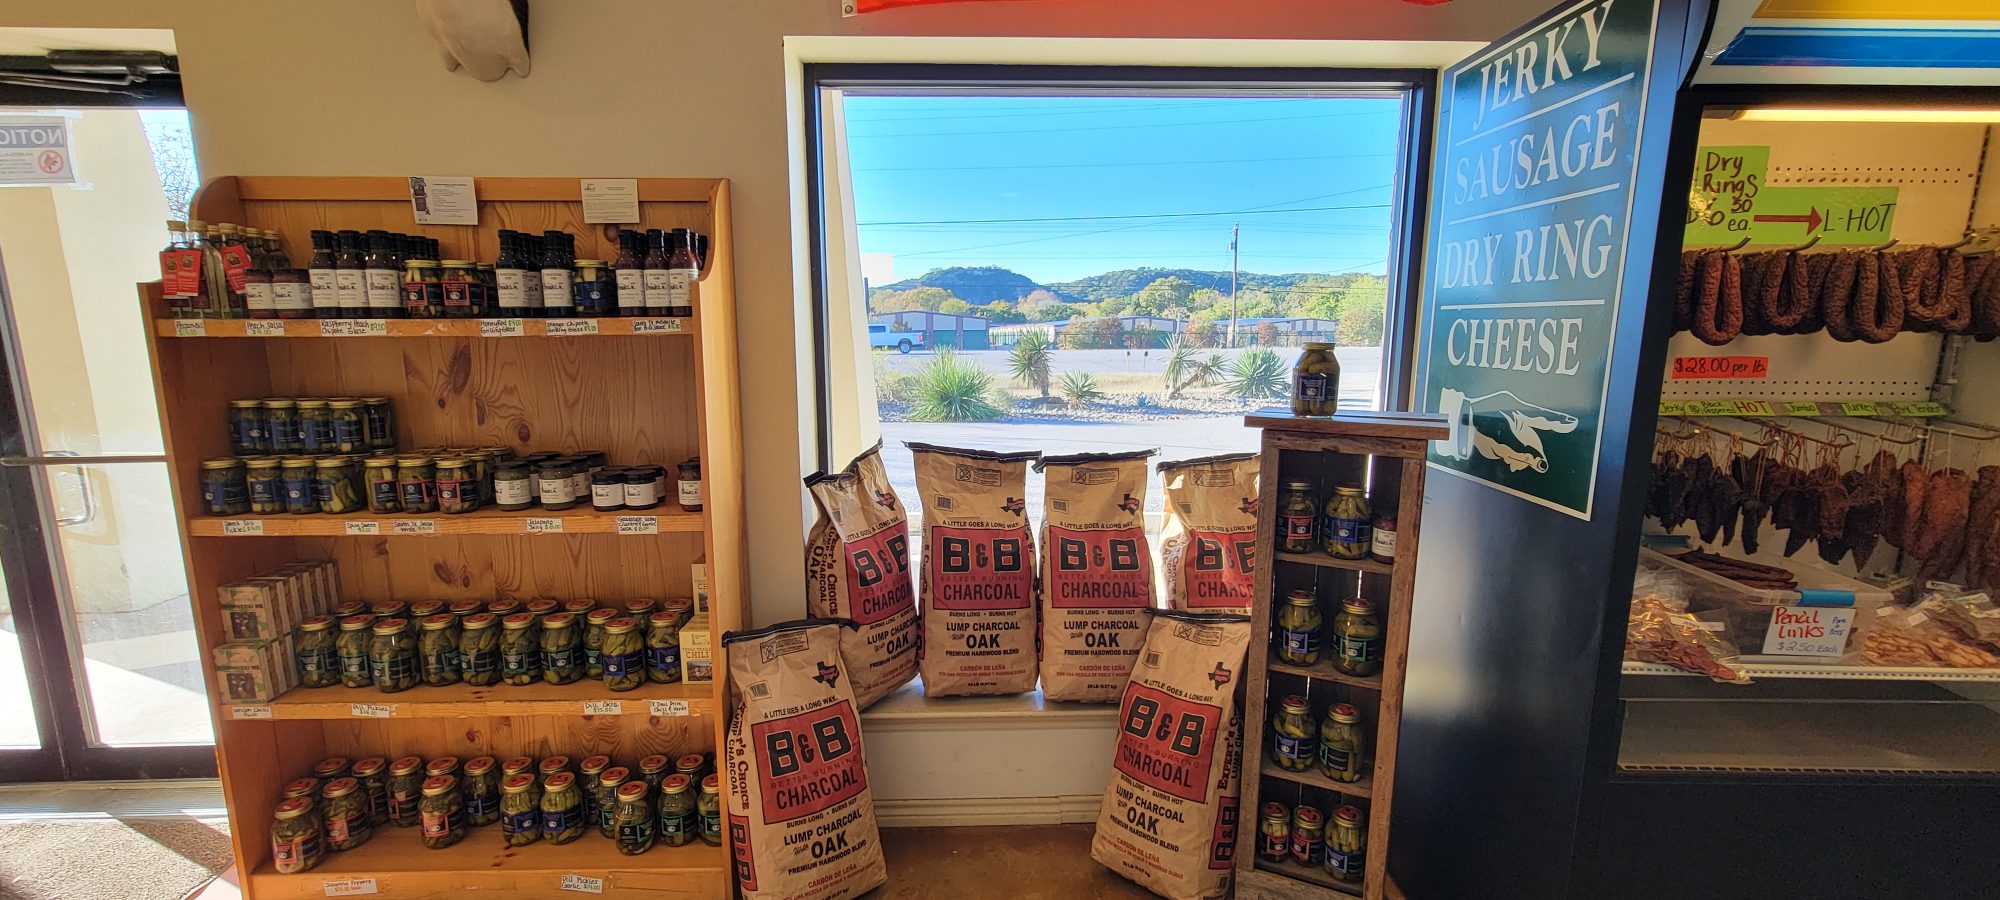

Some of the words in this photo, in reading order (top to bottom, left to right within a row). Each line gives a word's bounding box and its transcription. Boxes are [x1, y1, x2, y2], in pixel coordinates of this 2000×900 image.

[1473, 4, 1611, 130] JERKY
[1454, 101, 1621, 207] SAUSAGE
[1705, 151, 1743, 178] Dry
[1823, 203, 1897, 232] L-HOT
[1443, 233, 1503, 290] DRY
[1511, 213, 1612, 284] RING
[247, 321, 265, 330] Peach
[1447, 317, 1583, 376] CHEESE
[1674, 357, 1730, 374] $28.00
[1731, 363, 1749, 377] per
[1733, 400, 1768, 413] HOT
[876, 520, 891, 530] LONG
[1064, 521, 1083, 529] LITTLE
[810, 546, 824, 581] OAK
[942, 536, 1022, 574] B&B
[1059, 535, 1140, 572] B&B
[819, 553, 827, 603] CHARCOAL
[1061, 582, 1139, 598] CHARCOAL
[827, 574, 838, 615] CHOICE
[943, 583, 1021, 601] CHARCOAL
[946, 622, 970, 632] LUMP
[972, 621, 1020, 632] CHARCOAL
[1064, 621, 1089, 630] LUMP
[1091, 620, 1139, 630] CHARCOAL
[1774, 606, 1820, 625] Pencil
[867, 631, 889, 645] LUMP
[886, 631, 909, 655] OAK
[966, 633, 1001, 649] OAK
[1084, 632, 1120, 648] OAK
[1816, 644, 1838, 653] Each
[1002, 648, 1020, 656] BLEND
[1149, 679, 1165, 691] LITTLE
[1166, 685, 1183, 696] GOES
[764, 711, 768, 719] A
[769, 709, 786, 718] LITTLE
[806, 700, 822, 710] LONG
[1124, 695, 1207, 758] B&B
[765, 715, 853, 778] B&B
[1155, 750, 1200, 769] BURNING
[728, 739, 739, 796] CHARCOAL
[1123, 745, 1192, 788] CHARCOAL
[737, 760, 750, 810] CHOICE
[770, 774, 808, 790] BETTER
[776, 767, 858, 810] CHARCOAL
[1132, 780, 1145, 792] LONG
[1152, 790, 1171, 802] BURNS
[1171, 797, 1184, 806] HOT
[786, 819, 806, 829] BURNS
[807, 813, 824, 824] LONG
[831, 803, 848, 814] BURNS
[1116, 784, 1134, 801] LUMP
[1135, 796, 1184, 824] CHARCOAL
[784, 830, 813, 846] LUMP
[816, 808, 862, 836] CHARCOAL
[1109, 813, 1128, 831] PREMIUM
[1129, 825, 1159, 845] HARDWOOD
[1159, 840, 1179, 853] BLEND
[1127, 806, 1160, 836] OAK
[788, 861, 818, 875] PREMIUM
[819, 848, 851, 866] HARDWOOD
[851, 839, 867, 853] BLEND
[811, 830, 848, 859] OAK
[577, 876, 598, 884] Pickles
[834, 870, 842, 879] DE
